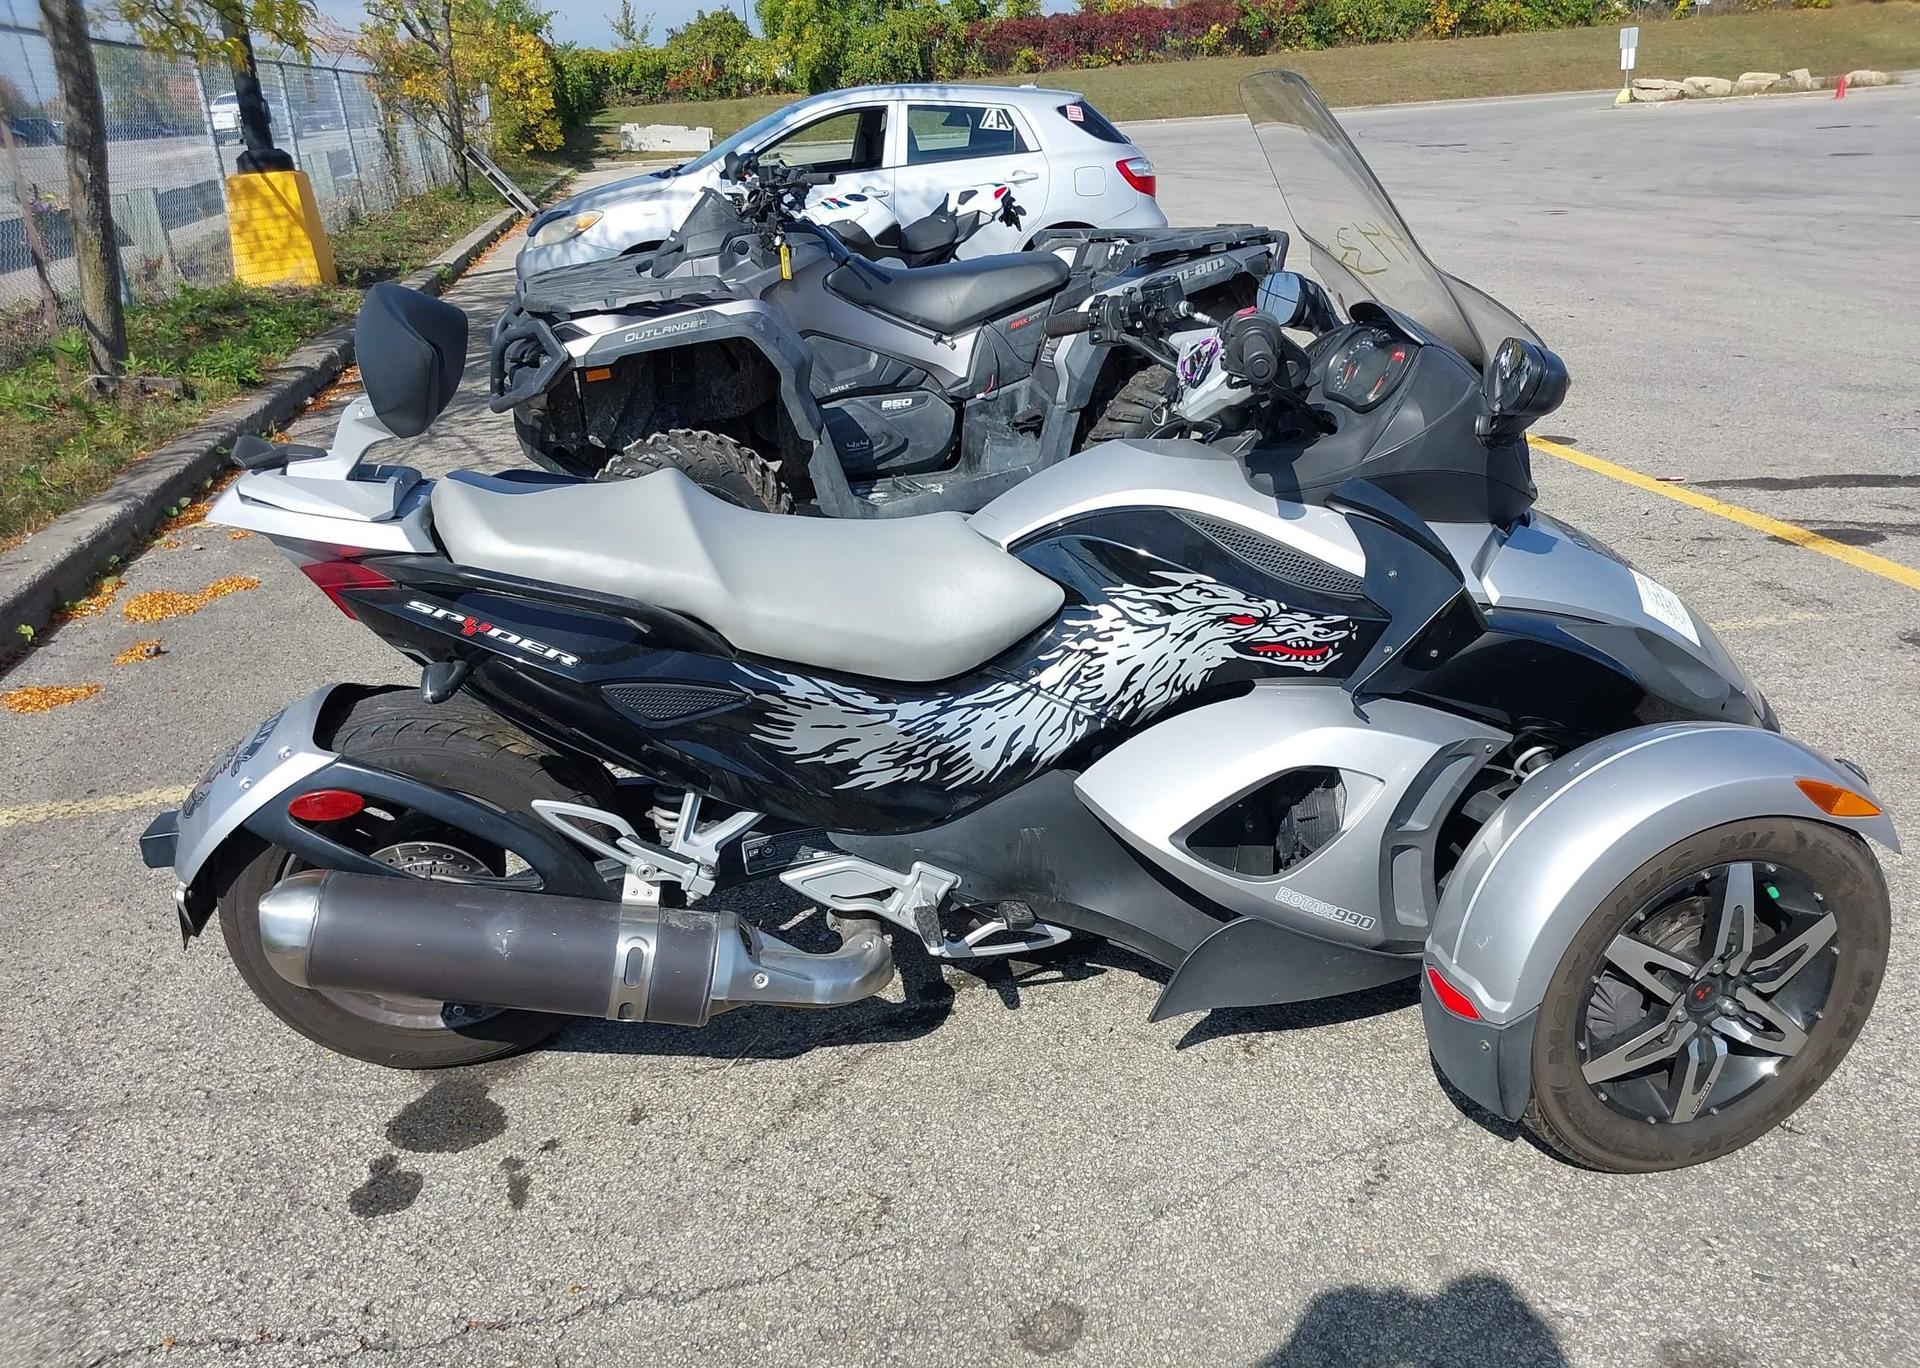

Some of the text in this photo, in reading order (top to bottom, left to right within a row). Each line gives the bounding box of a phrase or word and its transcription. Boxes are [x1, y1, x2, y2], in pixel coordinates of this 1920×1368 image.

[624, 319, 708, 342] OUTLANDER
[829, 383, 850, 394] ROTAX
[881, 398, 913, 408] 850
[404, 600, 580, 668] SPYDER
